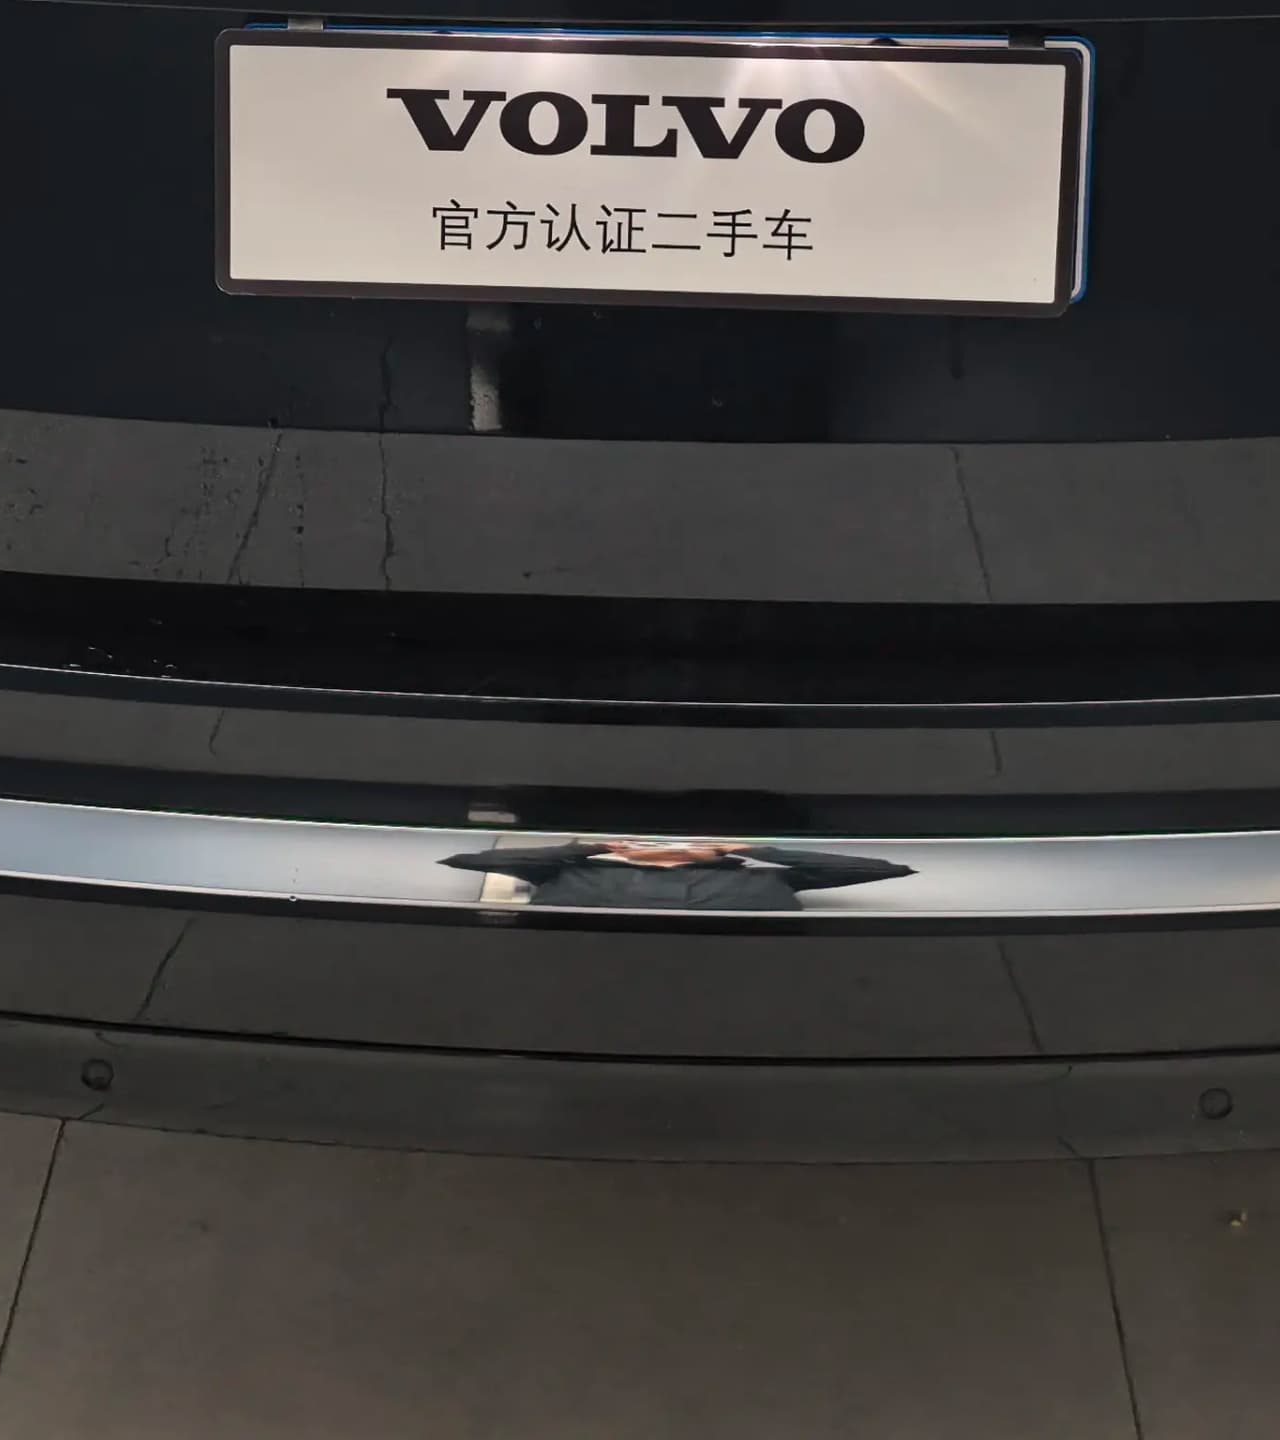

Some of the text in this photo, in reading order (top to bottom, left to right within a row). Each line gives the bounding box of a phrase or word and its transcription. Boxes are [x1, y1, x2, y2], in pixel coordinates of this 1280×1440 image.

[386, 88, 866, 163] VOLVO
[431, 200, 814, 261] 官方认证二手车
